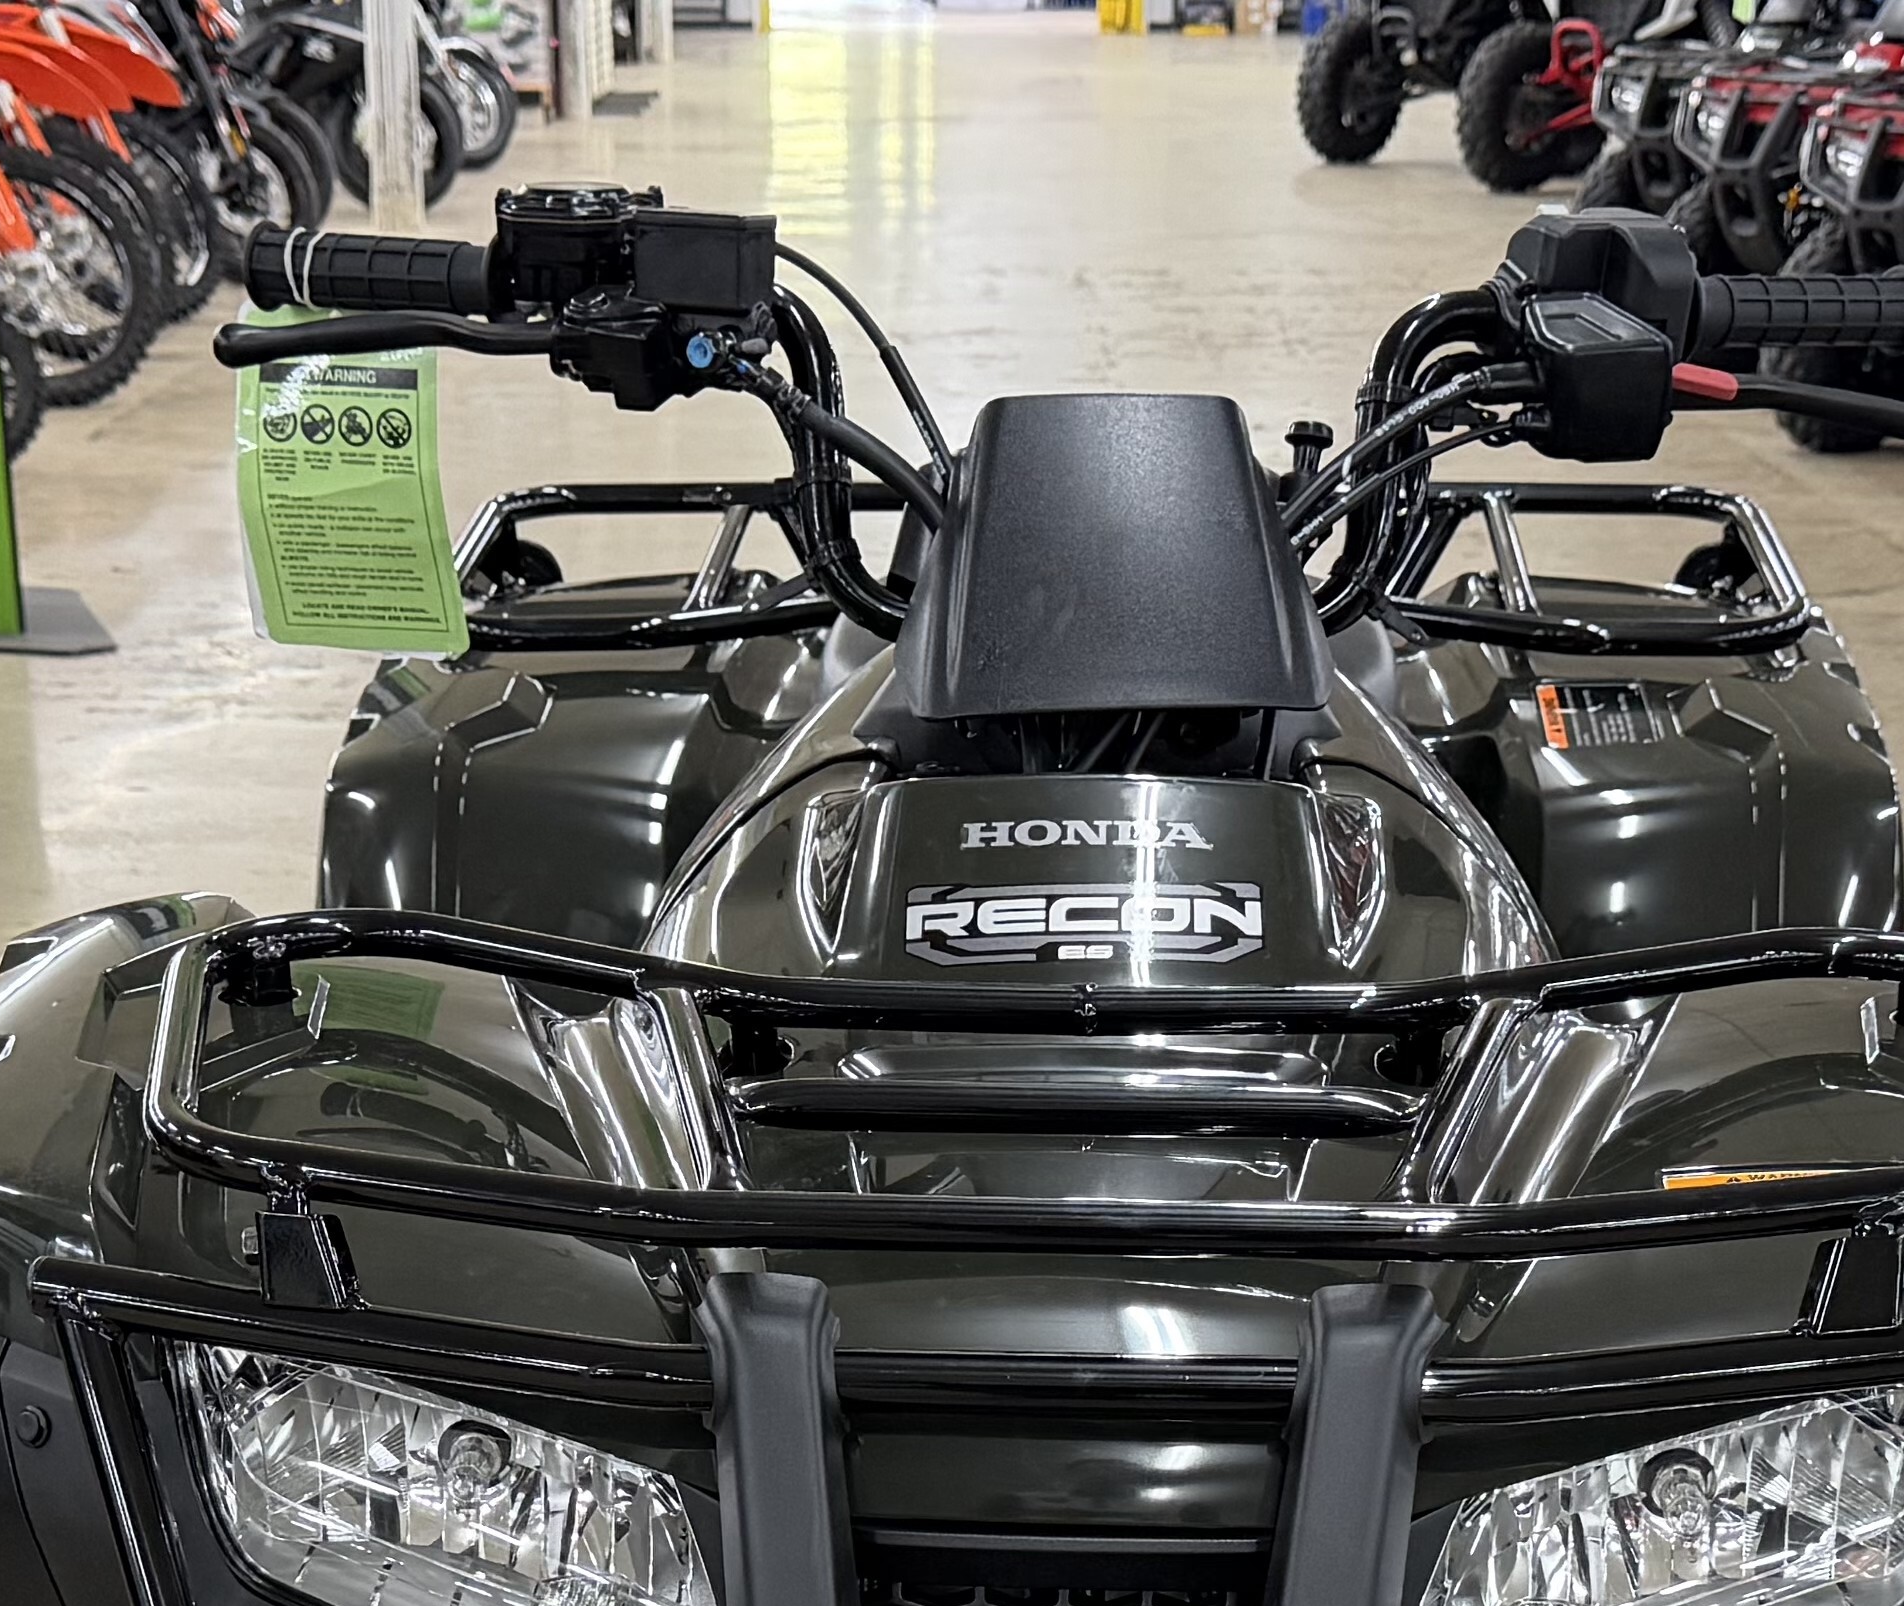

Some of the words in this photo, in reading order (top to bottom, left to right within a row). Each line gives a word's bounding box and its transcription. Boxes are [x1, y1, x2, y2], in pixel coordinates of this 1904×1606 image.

[959, 819, 1214, 851] HONDA
[905, 896, 1264, 941] RECON
[1057, 944, 1114, 961] ES
